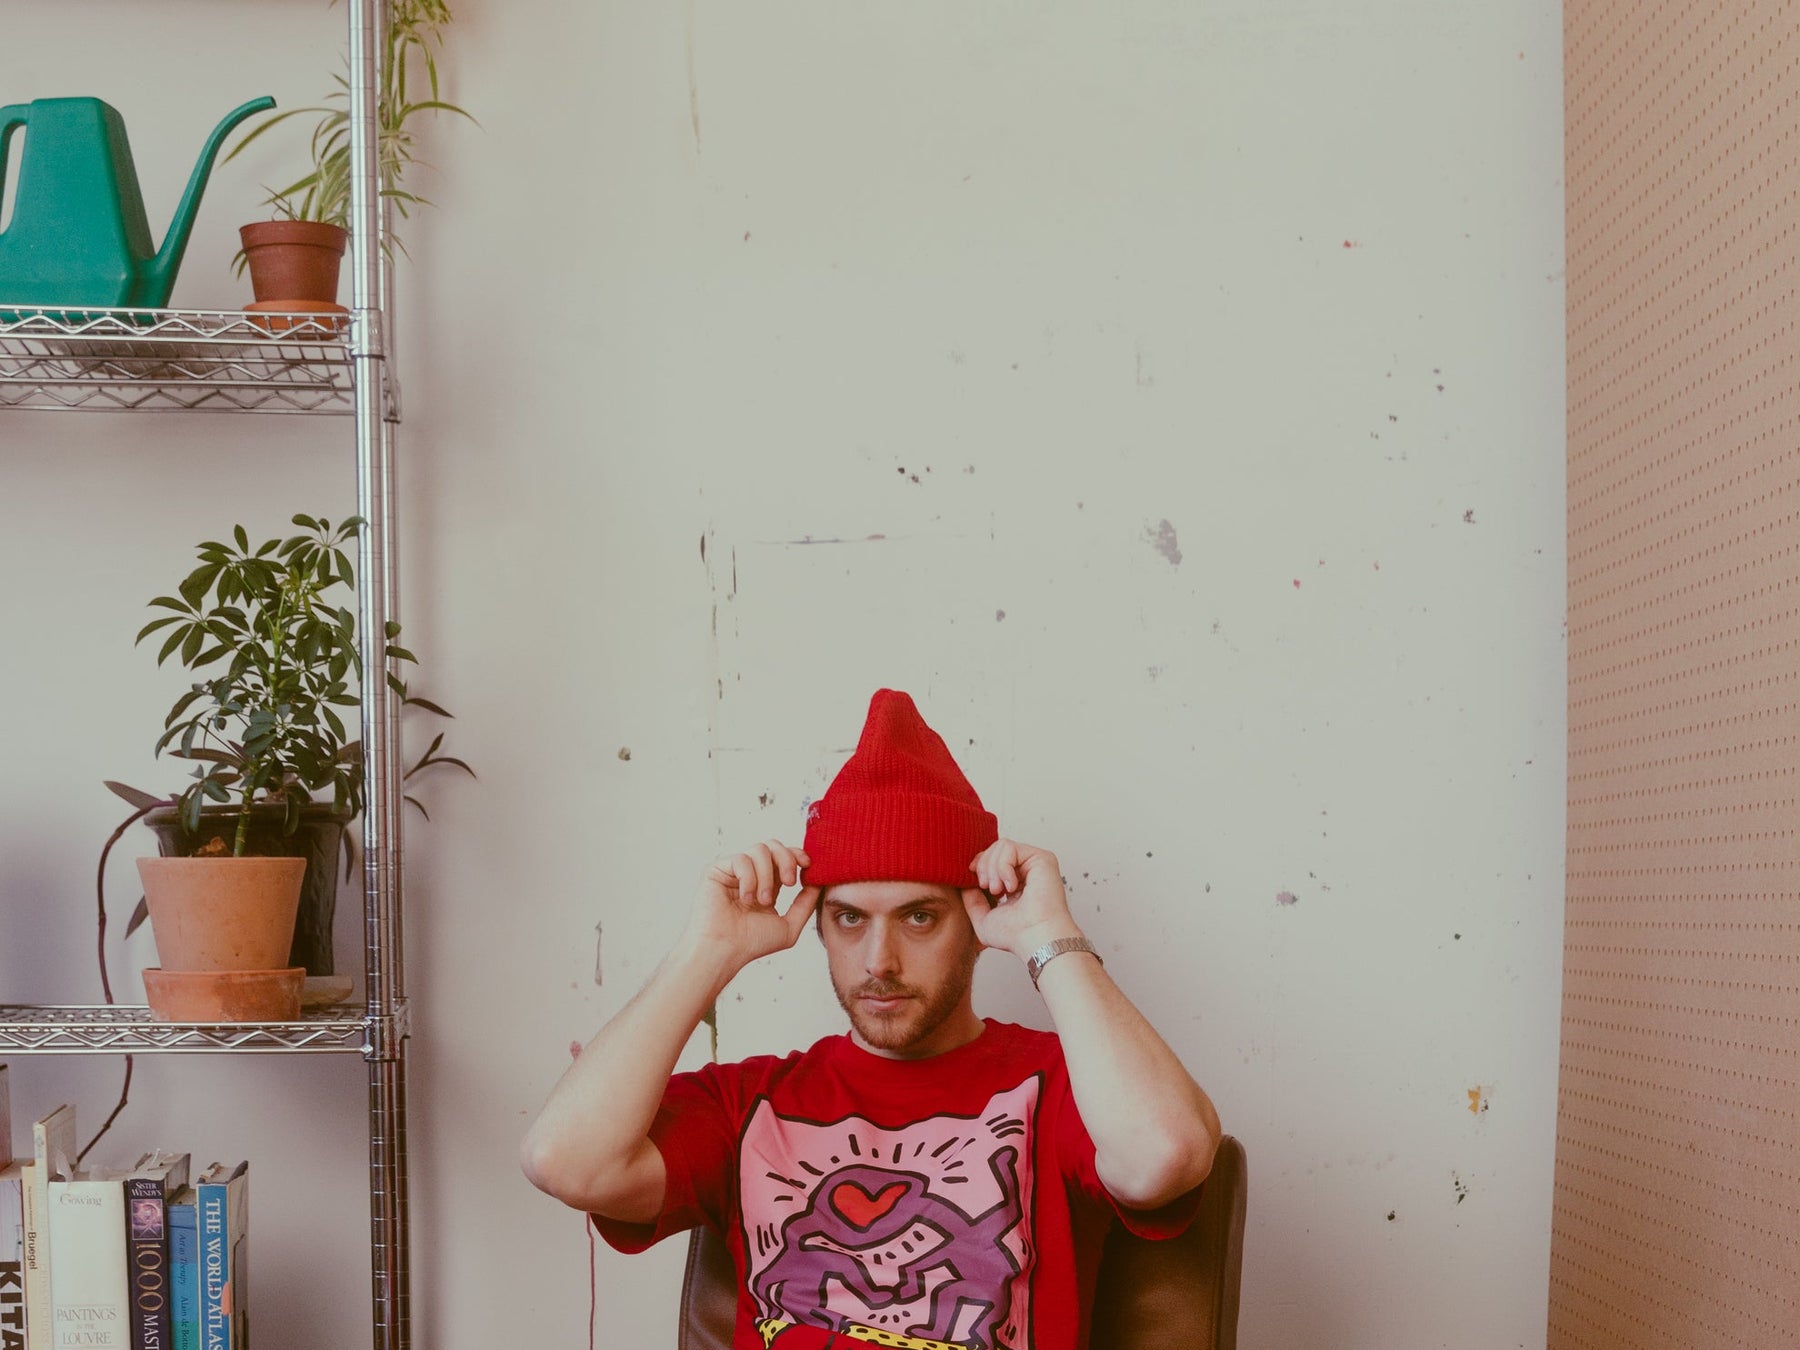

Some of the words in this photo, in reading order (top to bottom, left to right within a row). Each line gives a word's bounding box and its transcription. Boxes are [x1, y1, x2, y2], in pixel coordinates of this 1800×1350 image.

[59, 1193, 103, 1207] Gowing
[205, 1199, 221, 1234] THE
[27, 1231, 37, 1270] Bruegel
[136, 1242, 164, 1312] 1000
[207, 1237, 222, 1301] WORLD
[56, 1308, 117, 1321] PAINTINGS
[62, 1331, 112, 1345] LOUVRE
